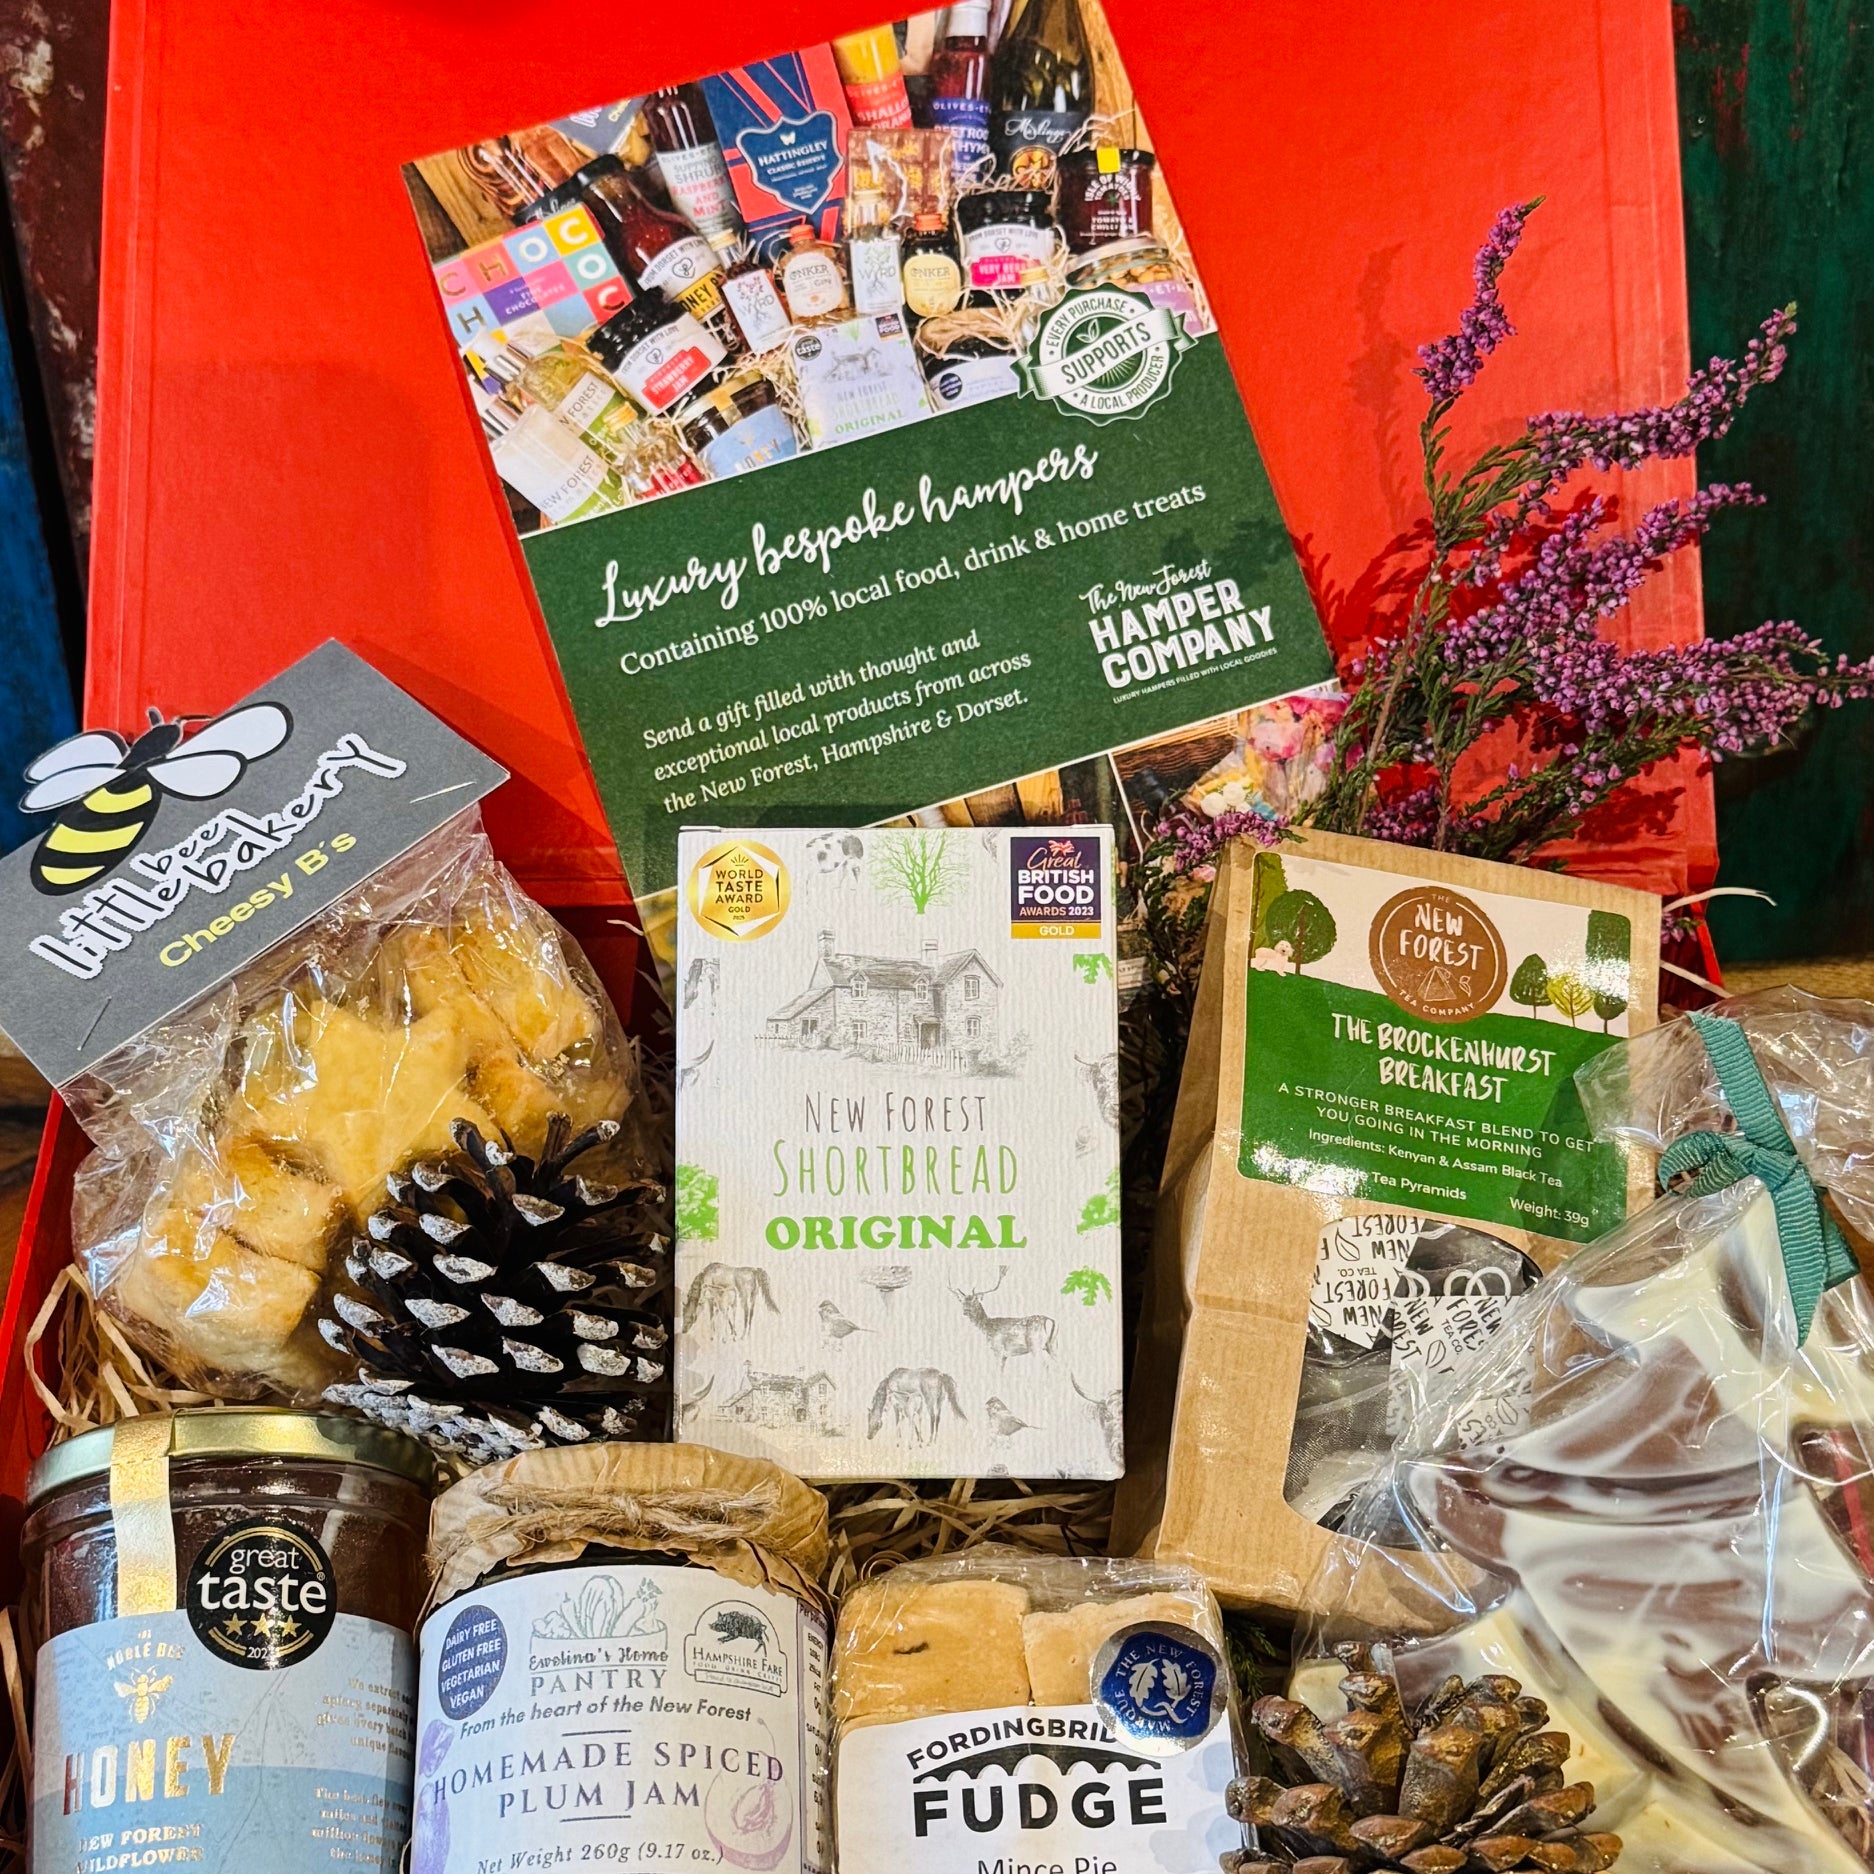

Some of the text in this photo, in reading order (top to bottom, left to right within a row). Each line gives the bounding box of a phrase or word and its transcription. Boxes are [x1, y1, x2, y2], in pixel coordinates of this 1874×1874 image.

[758, 140, 827, 167] HATTINGLEY
[693, 200, 727, 218] MINT
[695, 191, 719, 205] AND
[978, 263, 1000, 274] VERY
[1046, 295, 1128, 348] EVERY PURCHASE
[1061, 322, 1153, 385] SUPPORTS
[650, 355, 695, 395] STRAWBERRY
[672, 374, 689, 392] JAM
[1079, 355, 1164, 411] A LOCAL PRODUCER
[567, 382, 599, 418] FOREST
[835, 412, 905, 434] ORIGINAL
[594, 444, 1098, 628] Luxury bespoke hampers
[620, 484, 1206, 675] Containing 100% local food, drink & home treats
[1079, 558, 1212, 615] The New Forest
[1088, 578, 1246, 654] HAMPER
[1101, 605, 1275, 689] COMPANY
[643, 628, 981, 750] Send a gift filled with thought and
[1113, 647, 1278, 705] LUXURY HAMPERS FILLED WITH LOCAL GOODIES
[654, 652, 1032, 781] exceptional local products from across
[663, 688, 1029, 814] the New Forest, Hampshire & Dorset.
[32, 735, 403, 976] little bakery
[137, 820, 222, 877] bee
[1027, 847, 1082, 870] Great
[715, 869, 764, 880] WORLD
[716, 881, 763, 893] TASTE
[1018, 869, 1095, 885] BRITISH
[715, 893, 764, 905] AWARD
[728, 906, 751, 914] GOLD
[1018, 884, 1095, 905] FOOD
[1020, 906, 1095, 917] AWARDS 2023
[1431, 893, 1451, 904] THE
[160, 872, 294, 968] Cheesy
[1039, 925, 1076, 937] GOLD
[1414, 903, 1464, 937] NEW
[1400, 930, 1485, 971] FOREST
[1399, 988, 1476, 1017] TEA COMPANY
[1332, 1012, 1557, 1077] THE BROCKENHURST
[1379, 1056, 1509, 1104] BREAKFAST
[805, 1091, 986, 1134] NEW FOREST
[1278, 1083, 1596, 1154] A STRONGER BREAKFAST BLEND TO GET
[1316, 1105, 1543, 1160] YOU GOING IN THE MORNING
[773, 1139, 1018, 1197] SHORTBREAD
[1309, 1127, 1564, 1189] Ingredients: Kenyan & Assam Black Tea
[1372, 1171, 1467, 1202] Tea Pyramids
[1351, 1215, 1420, 1238] FOREST
[1509, 1196, 1591, 1228] Weight: 39g
[765, 1215, 1028, 1251] ORIGINAL
[1371, 1239, 1411, 1260] NEW
[1337, 1266, 1377, 1278] TEA CO.
[1324, 1279, 1391, 1304] FOREST
[1342, 1305, 1383, 1327] NEW
[1404, 1298, 1434, 1337] NEW
[1441, 1319, 1464, 1356] TEA CO.
[229, 1546, 300, 1575] great
[196, 1571, 327, 1615] taste
[445, 1618, 498, 1651] DAIRY FREE
[106, 1641, 186, 1671] NOBLE BEE
[441, 1638, 502, 1673] GLUTEN FREE
[692, 1646, 758, 1671] HAMPSHIRE
[761, 1658, 783, 1677] FARE
[441, 1659, 501, 1694] VEGETARIAN
[530, 1668, 668, 1697] PANTRY
[1115, 1649, 1141, 1678] THE
[1145, 1643, 1184, 1659] NEW
[1185, 1660, 1205, 1718] FOREST
[450, 1685, 485, 1709] VEGAN
[459, 1695, 753, 1741] From the heart of the New Forest
[63, 1732, 237, 1817] HONEY
[434, 1741, 784, 1805] HOMEMADE SPICED
[499, 1779, 701, 1818] PLUM JAM
[912, 1777, 1168, 1838] FUDGE
[79, 1824, 204, 1854] NEW FOREST
[477, 1842, 725, 1874] Net Weight 260g (9.17 oz.)
[977, 1856, 1118, 1874] Mince Pie
